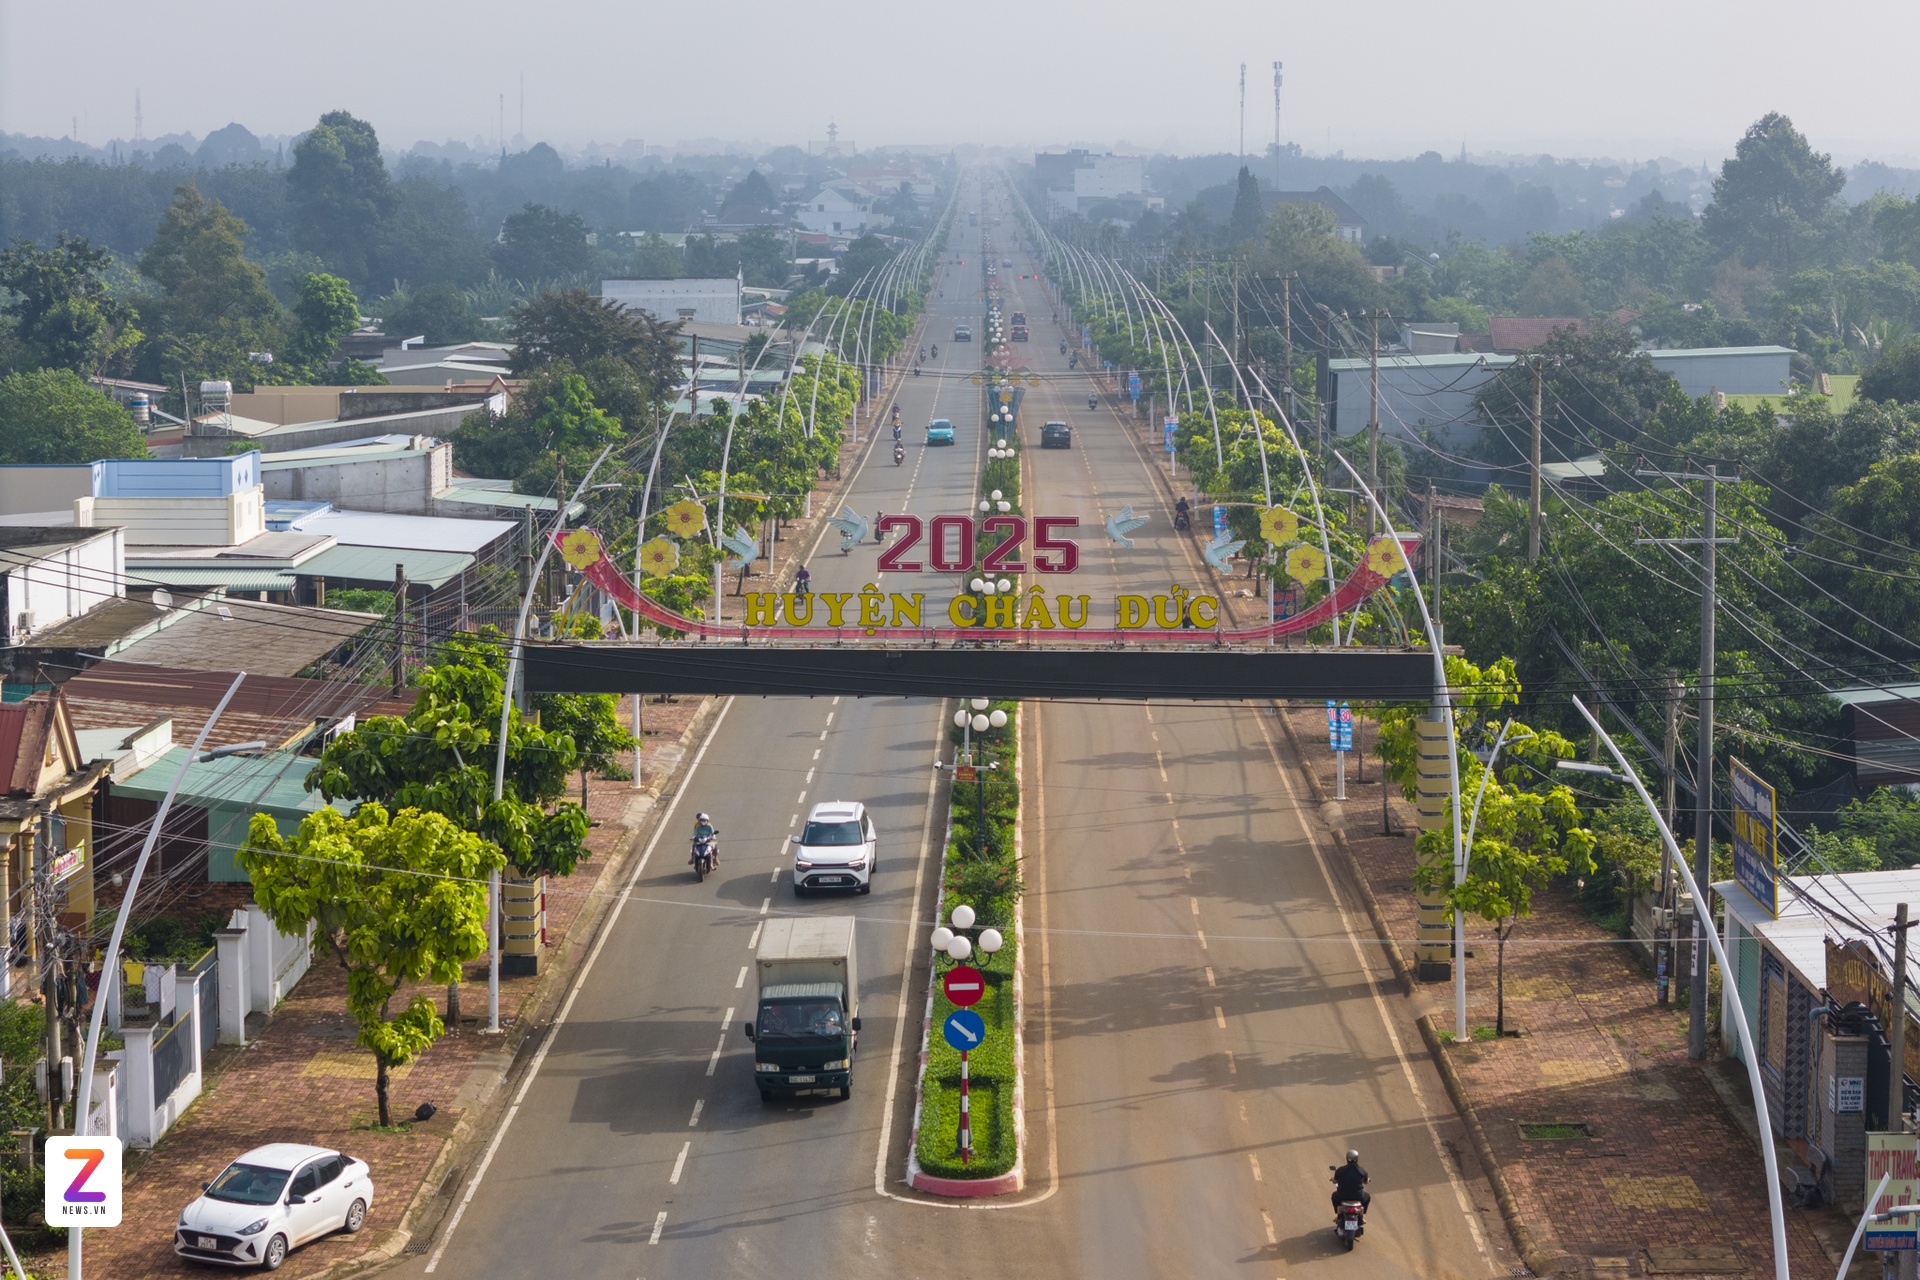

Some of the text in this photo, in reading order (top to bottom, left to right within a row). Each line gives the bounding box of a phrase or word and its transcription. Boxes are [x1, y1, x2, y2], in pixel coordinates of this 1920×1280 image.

[878, 514, 1079, 573] 2025
[744, 583, 1218, 636] HUYỆN CHÂU ĐỨC
[1869, 1139, 1890, 1180] THỜI
